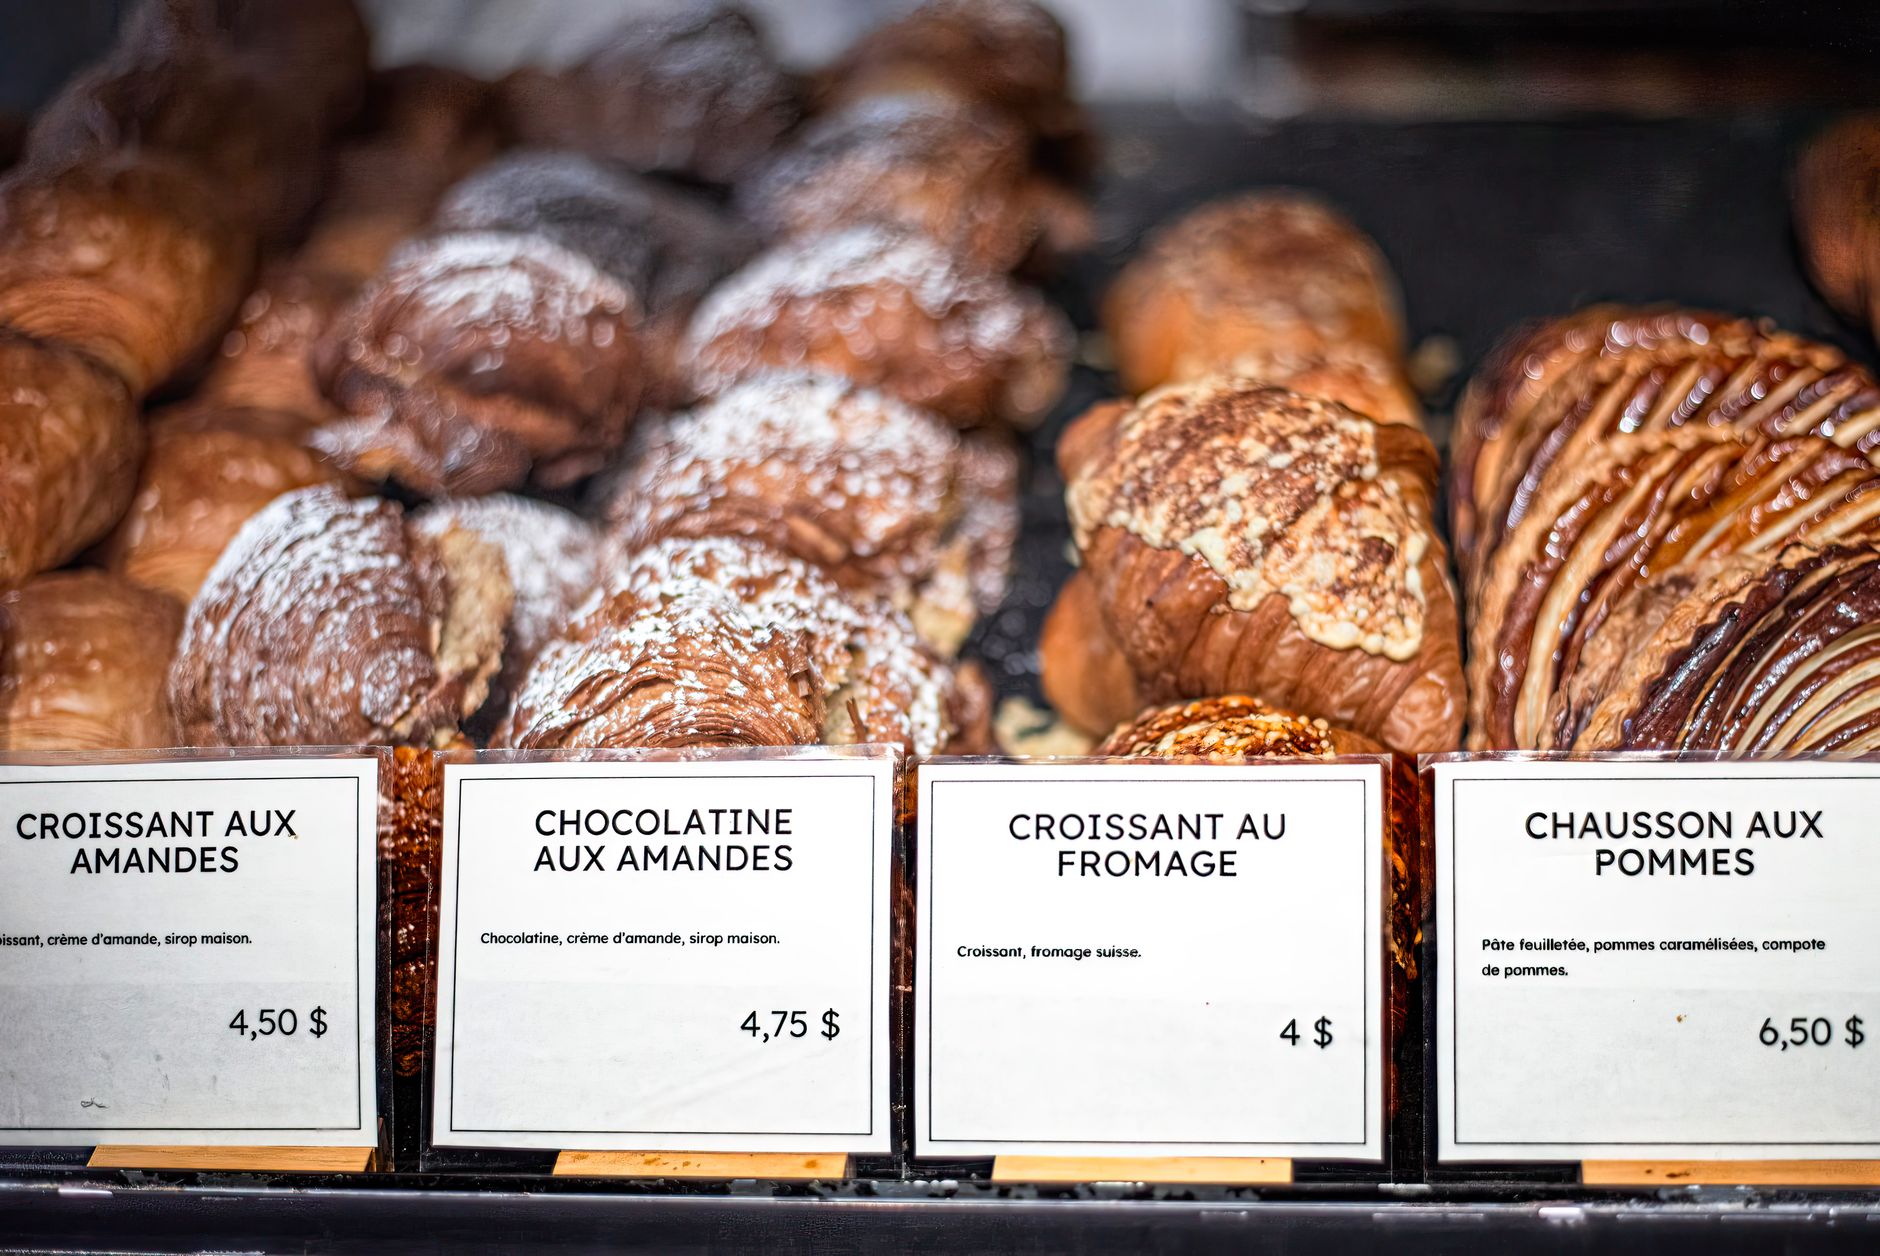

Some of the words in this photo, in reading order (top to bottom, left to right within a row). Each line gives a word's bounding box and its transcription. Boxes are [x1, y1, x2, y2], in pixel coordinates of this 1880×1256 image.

[16, 810, 214, 841] CROISSANT
[224, 809, 298, 839] AUX
[535, 808, 793, 837] CHOCOLATINE
[1008, 813, 1224, 841] CROISSANT
[1236, 813, 1286, 841] AU
[1525, 811, 1733, 840] CHAUSSON
[1745, 810, 1825, 839] AUX
[69, 845, 239, 875] AMANDES
[533, 845, 606, 872] AUX
[616, 844, 793, 872] AMANDES
[1057, 850, 1237, 878] FROMAGE
[1595, 847, 1756, 877] POMMES
[46, 933, 88, 946] crème
[164, 932, 198, 948] sirop
[200, 931, 253, 945] maison.
[480, 931, 563, 946] Chocolatine,
[566, 931, 609, 944] crème
[689, 931, 724, 947] sirop
[727, 931, 781, 945] maison.
[957, 944, 1027, 960] Croissant,
[1030, 945, 1092, 961] fromage
[1096, 945, 1142, 958] suisse.
[1481, 938, 1515, 951] Pâte
[1519, 938, 1590, 953] feuilletée,
[1593, 941, 1655, 954] pommes
[1659, 937, 1758, 953] caramélisées,
[1761, 938, 1826, 953] compote
[1481, 963, 1500, 976] de
[1504, 965, 1569, 979] pommes.
[228, 1008, 298, 1042] 4,50
[309, 1005, 328, 1039] $
[740, 1010, 808, 1044] 4,75
[820, 1007, 841, 1042] $
[1279, 1018, 1301, 1047] 4
[1313, 1015, 1333, 1050] $
[1758, 1017, 1832, 1052] 6,50
[1844, 1014, 1865, 1049] $
